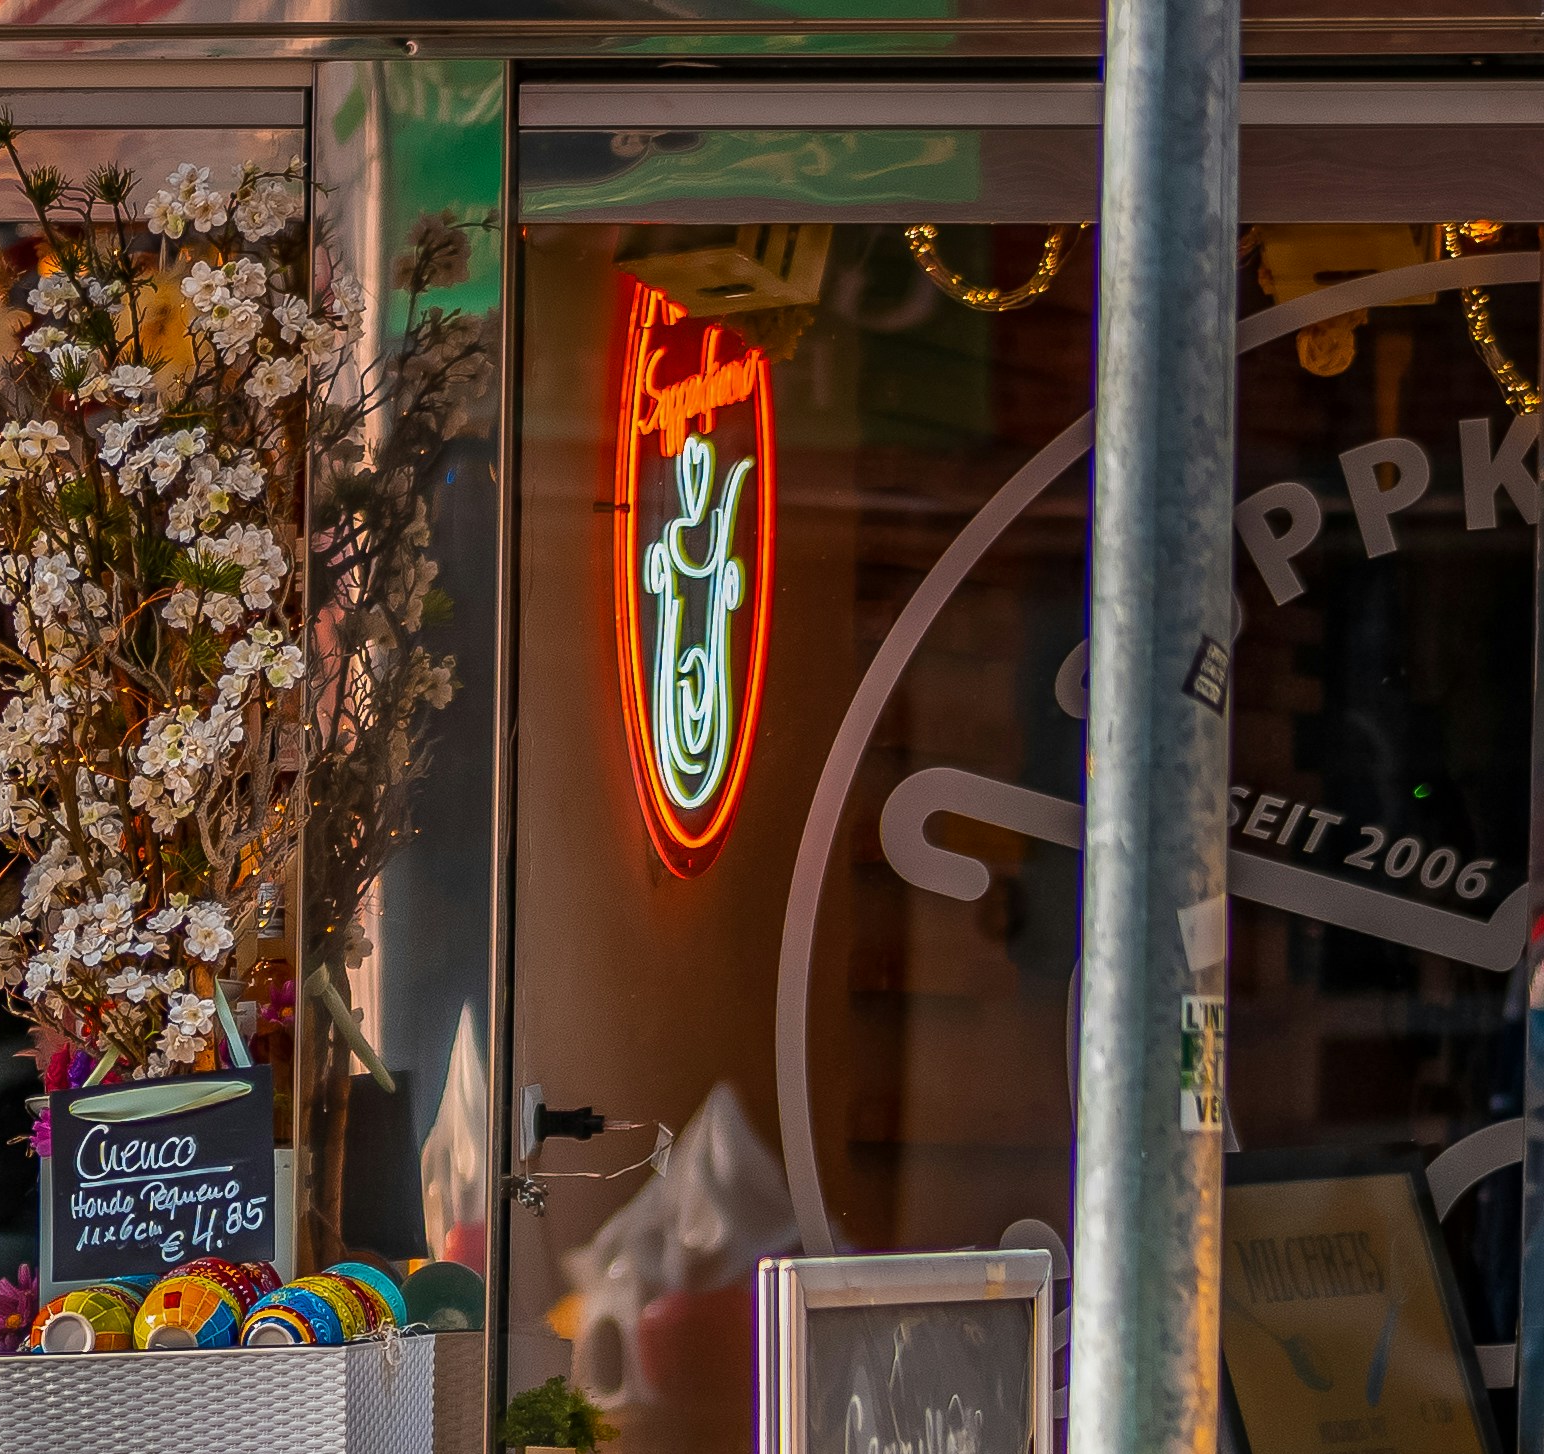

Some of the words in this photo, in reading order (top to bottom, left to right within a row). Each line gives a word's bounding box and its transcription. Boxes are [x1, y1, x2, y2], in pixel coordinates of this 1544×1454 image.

[1344, 825, 1497, 901] 2006
[76, 1124, 197, 1180] Cuenco
[71, 1189, 135, 1220] Hondo
[140, 1181, 240, 1221] Pequeno
[160, 1230, 185, 1262] €
[192, 1196, 267, 1252] 4.85
